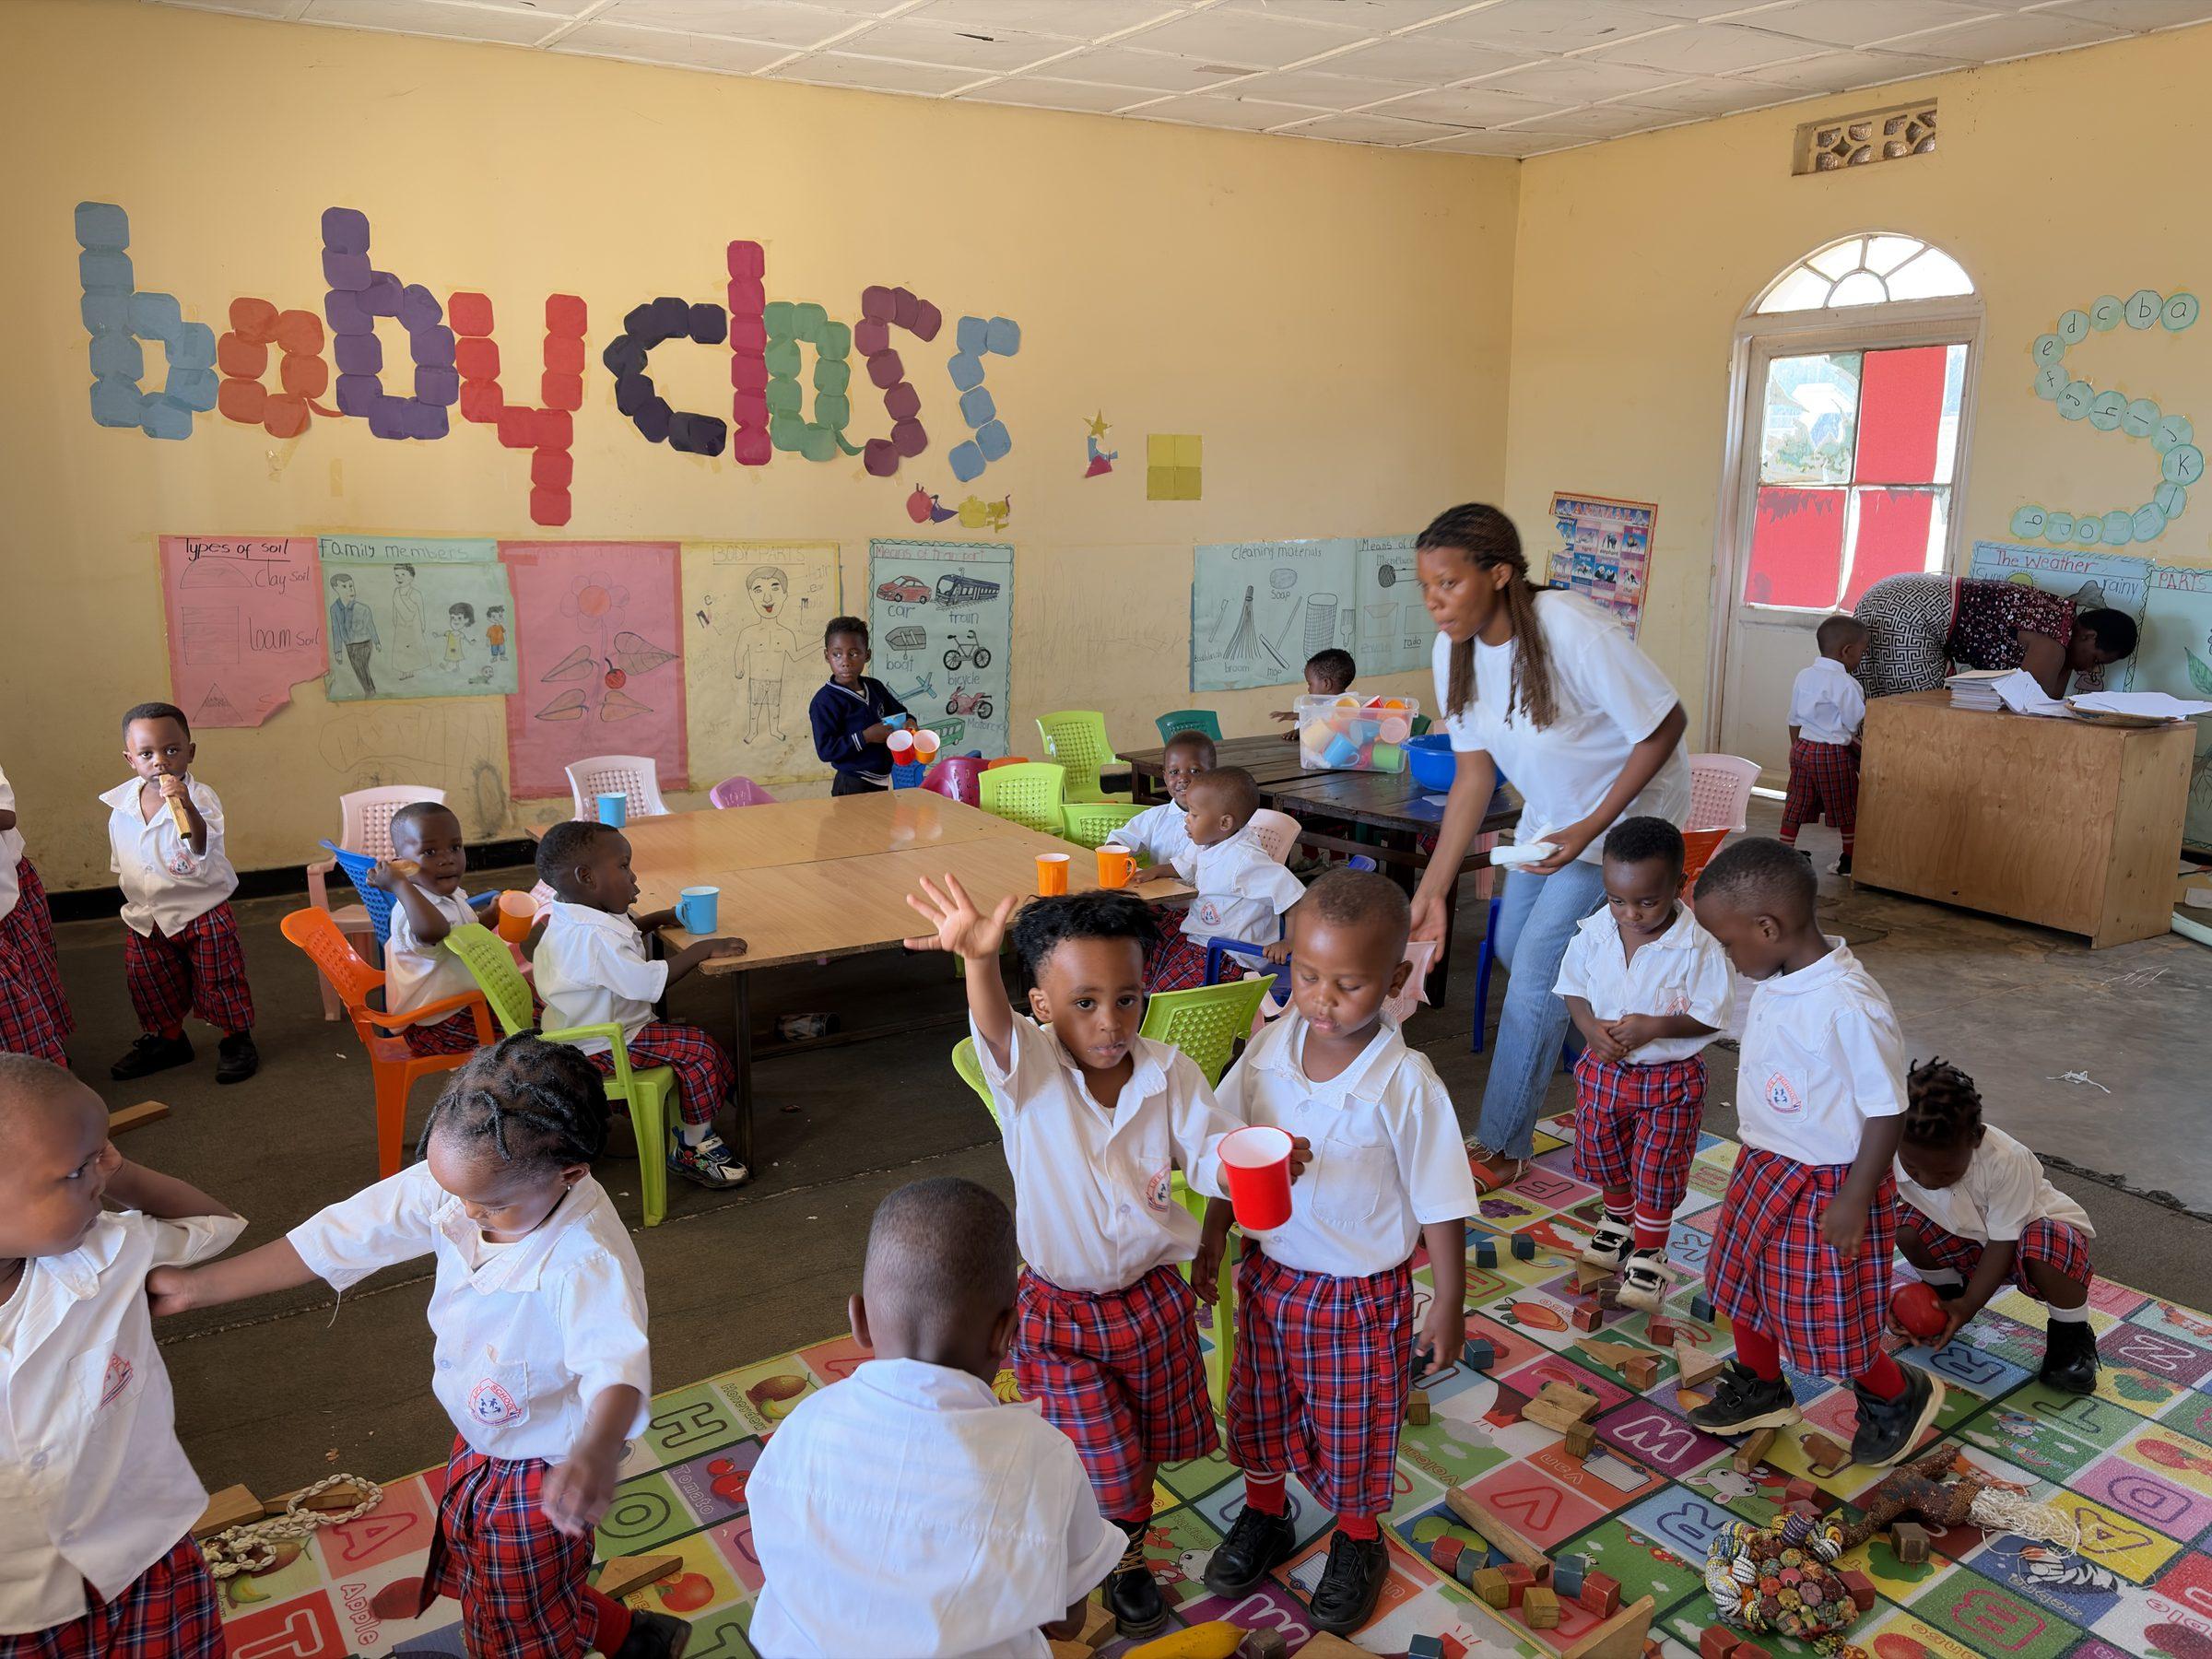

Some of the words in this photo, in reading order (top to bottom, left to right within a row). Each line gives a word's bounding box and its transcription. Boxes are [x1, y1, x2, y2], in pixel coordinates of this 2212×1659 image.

[175, 536, 230, 561] Types
[236, 543, 252, 559] of
[262, 538, 288, 555] soil
[318, 537, 375, 559] Family
[384, 545, 469, 560] members
[712, 545, 751, 562] BODY
[758, 545, 806, 562] PARTS
[876, 545, 912, 559] Means
[1362, 538, 1393, 551] Means
[1995, 549, 2019, 567] The
[255, 559, 287, 595] Clay
[2158, 571, 2207, 592] PARTS
[2103, 578, 2139, 602] rainy
[888, 605, 916, 618] car
[949, 608, 980, 624] train
[886, 653, 914, 672] boat
[947, 671, 982, 687] bicycle
[1929, 1346, 2007, 1384] R
[650, 1402, 728, 1449] H
[1398, 1441, 1460, 1487] Volcan
[1540, 1453, 1584, 1485] Van
[676, 1464, 714, 1516] Tomato
[1489, 1485, 1564, 1532] V
[332, 1512, 418, 1562] A
[339, 1582, 382, 1647] Apple
[1951, 1588, 2047, 1652] B
[231, 1607, 324, 1659] T
